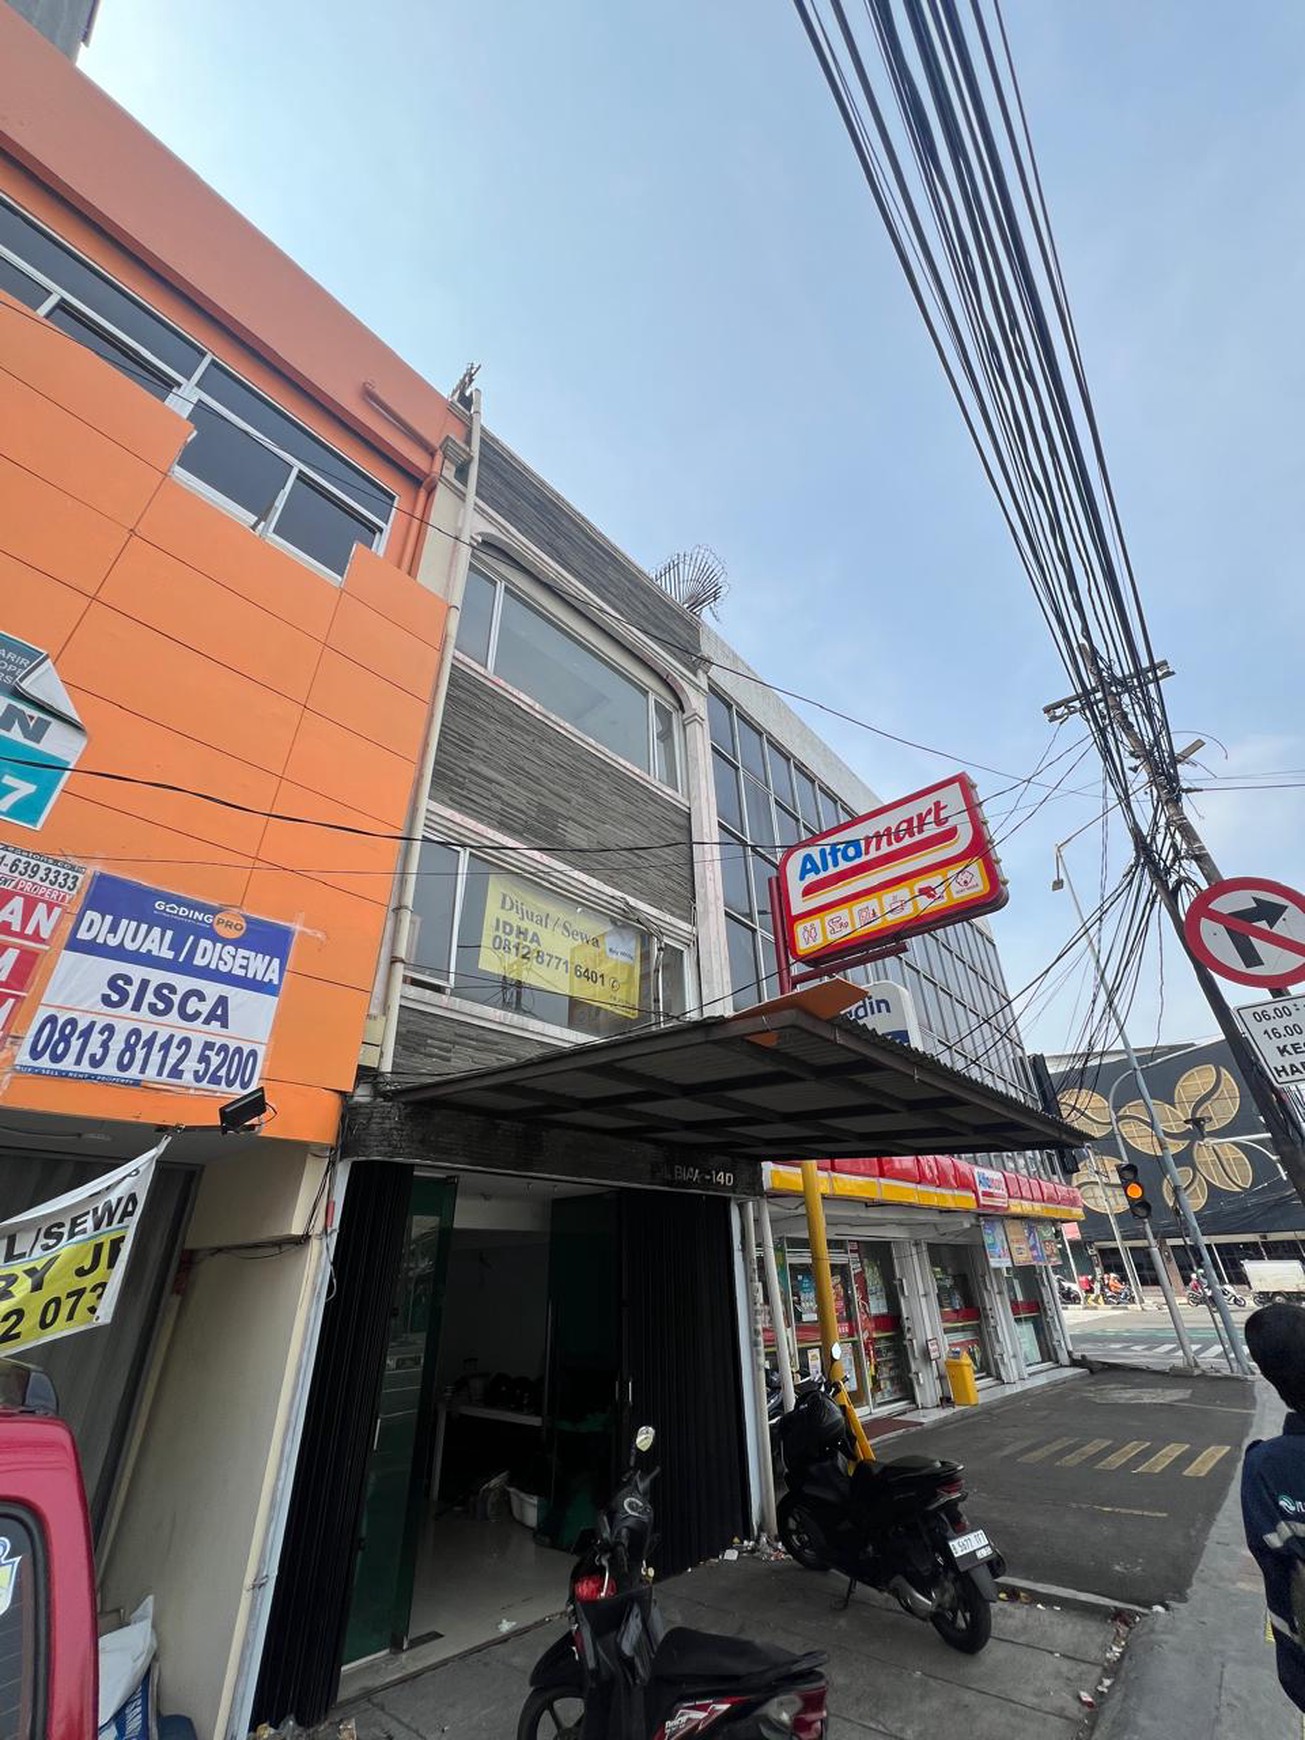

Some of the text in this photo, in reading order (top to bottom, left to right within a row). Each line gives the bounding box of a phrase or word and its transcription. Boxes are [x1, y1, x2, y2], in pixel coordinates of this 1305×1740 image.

[799, 800, 951, 881] Alfamart
[17, 879, 73, 905] PROPERTY
[215, 916, 244, 933] PRO
[494, 917, 542, 947] IDHA
[500, 892, 550, 930] Dijual
[561, 920, 600, 949] Sewa
[76, 910, 280, 985] DIJUAL / DISEWA
[492, 934, 606, 987] 0812 8771 6401
[101, 972, 230, 1029] SISCA
[1252, 1005, 1292, 1023] 06.00
[28, 1013, 116, 1069] 0813
[116, 1026, 192, 1080] 8112
[192, 1040, 259, 1090] 5200
[1263, 1023, 1303, 1041] 16.00
